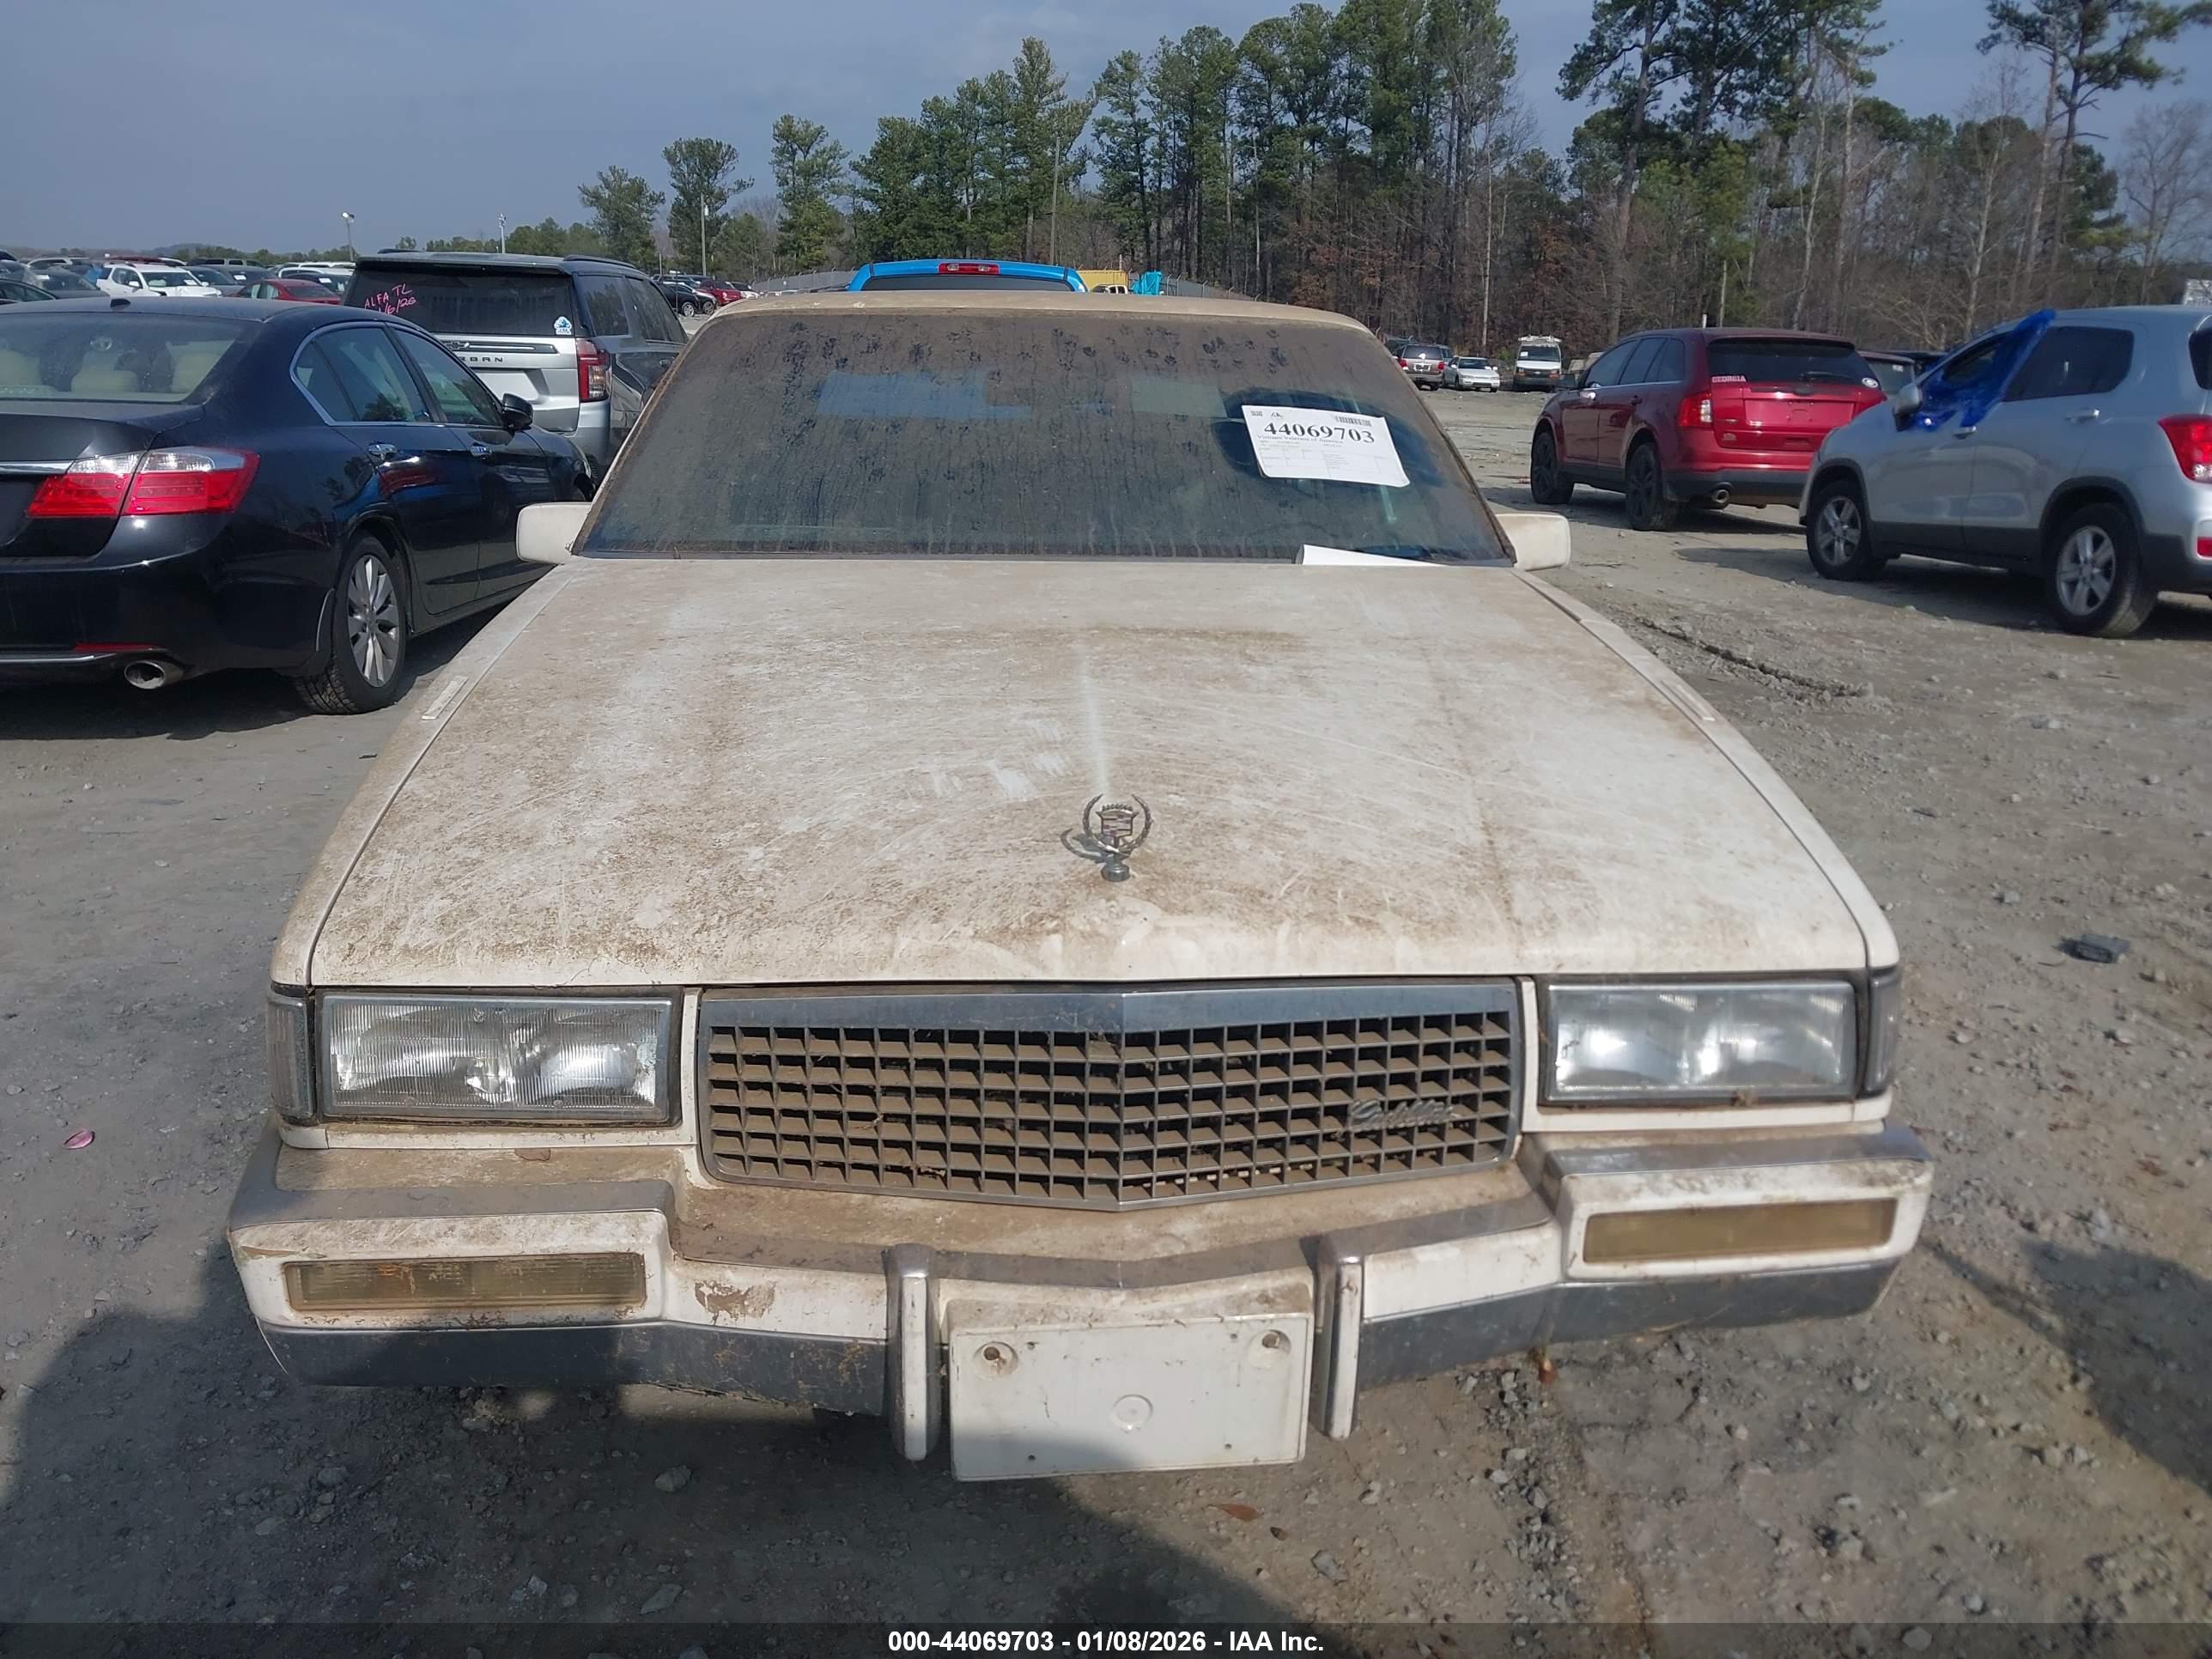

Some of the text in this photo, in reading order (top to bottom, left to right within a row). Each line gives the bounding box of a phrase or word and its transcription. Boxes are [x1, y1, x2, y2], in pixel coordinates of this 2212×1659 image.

[364, 283, 413, 310] ALFA TL
[1711, 374, 1747, 383] GEORGIA
[1264, 422, 1375, 444] 44069703
